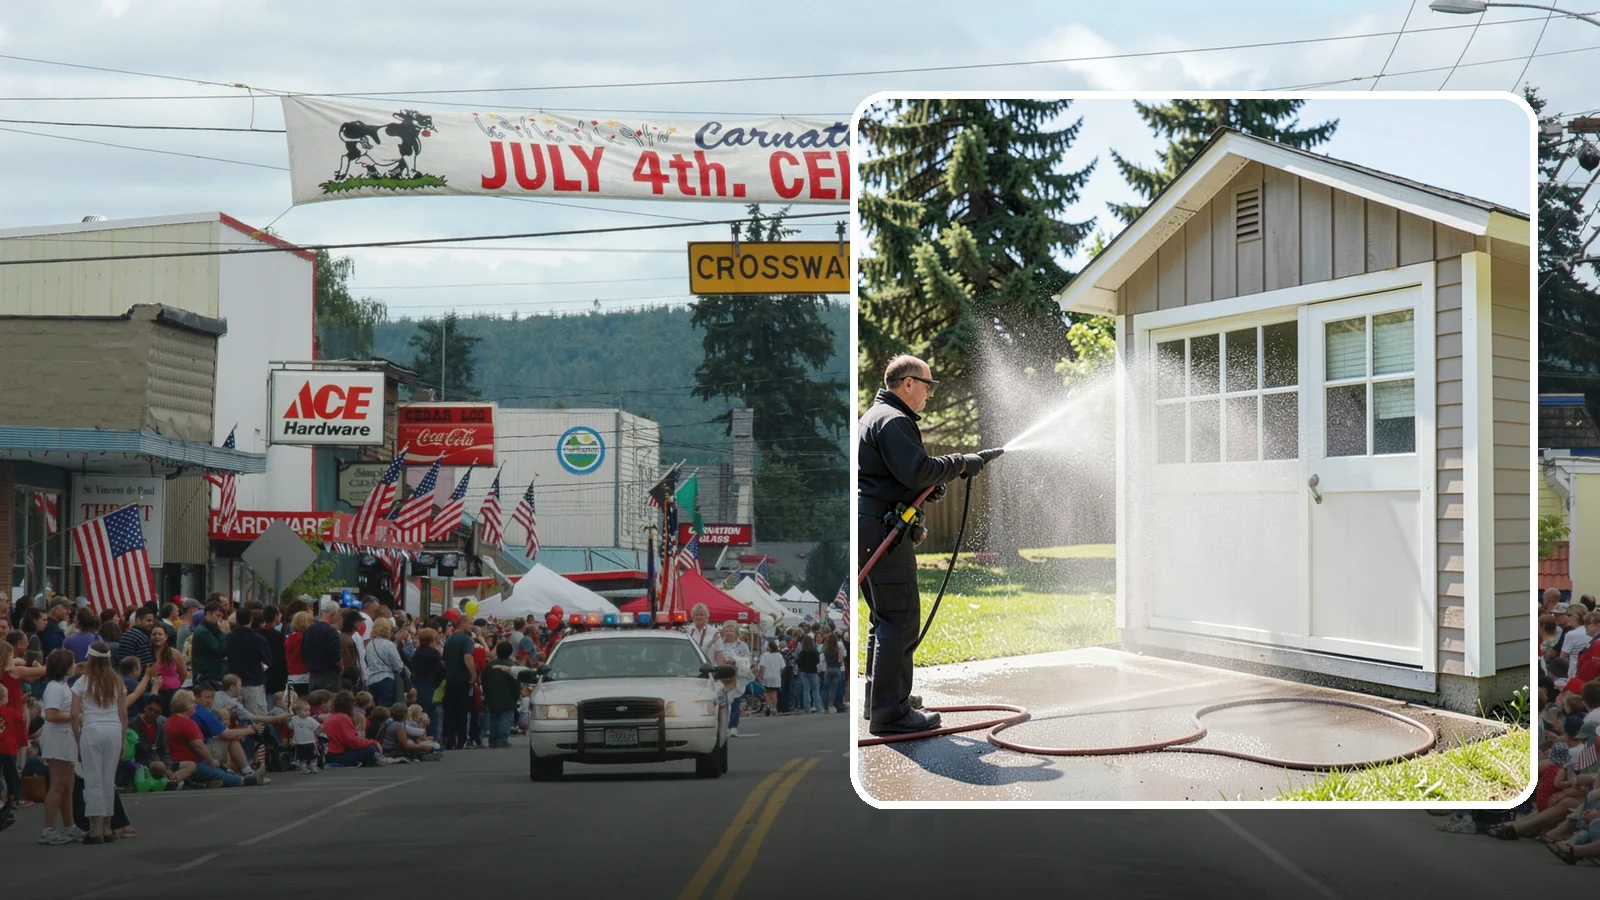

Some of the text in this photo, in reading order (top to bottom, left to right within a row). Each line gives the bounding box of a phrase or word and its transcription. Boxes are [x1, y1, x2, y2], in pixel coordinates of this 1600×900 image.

[695, 121, 850, 150] Carnat
[481, 141, 605, 192] JULY
[632, 150, 747, 198] 4th.
[697, 254, 850, 280] CROSSWA
[283, 380, 373, 420] ACE
[405, 409, 485, 422] CEDAR LOG
[284, 421, 370, 436] Hardware
[416, 428, 477, 446] Coca-Cola
[353, 467, 385, 481] Simpl
[83, 485, 155, 495] St. Vincent de Paul
[212, 516, 330, 535] HARDARE
[688, 526, 741, 535] CRNATION
[699, 535, 730, 543] GLASS
